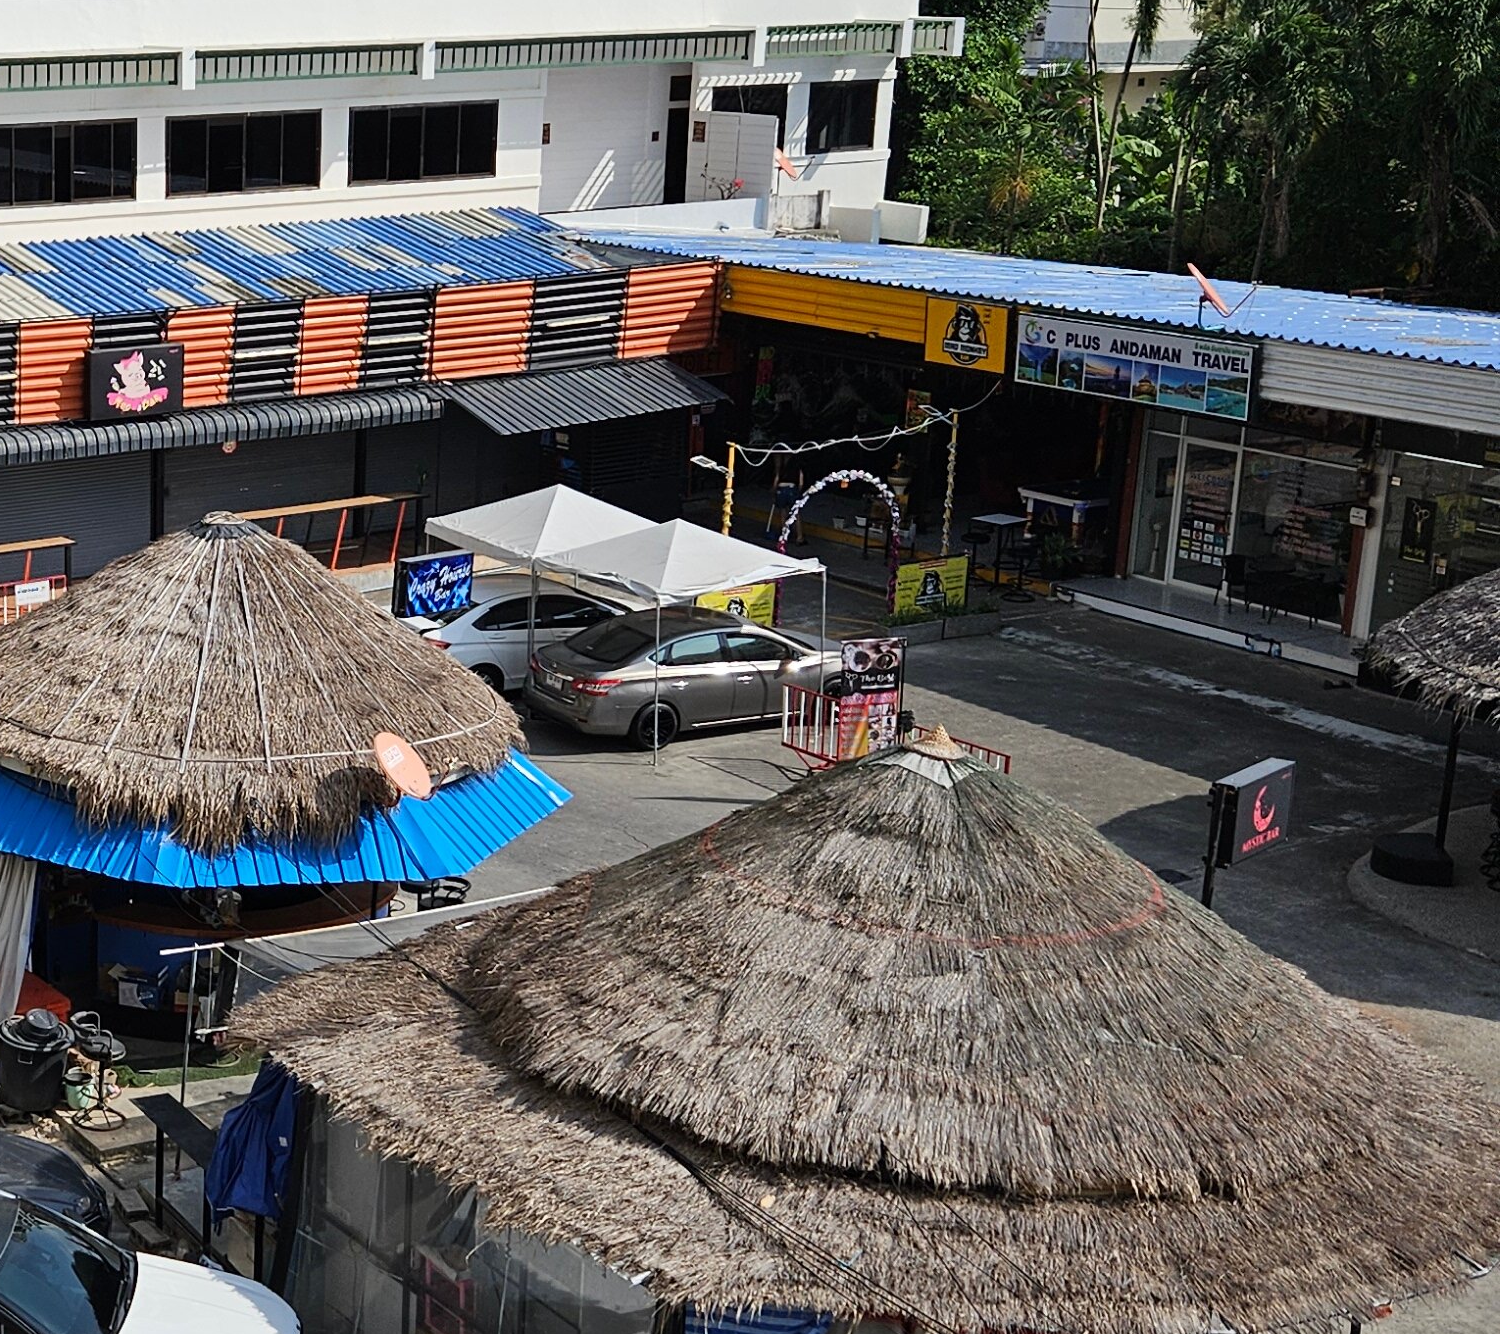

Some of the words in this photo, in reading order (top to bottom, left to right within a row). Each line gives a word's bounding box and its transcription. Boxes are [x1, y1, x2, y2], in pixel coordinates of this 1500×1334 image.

[1046, 329, 1057, 344] C
[1065, 332, 1101, 351] PLUS
[1109, 338, 1182, 364] ANDAMAN
[1192, 350, 1250, 374] TRAVEL
[1266, 826, 1280, 842] BAR
